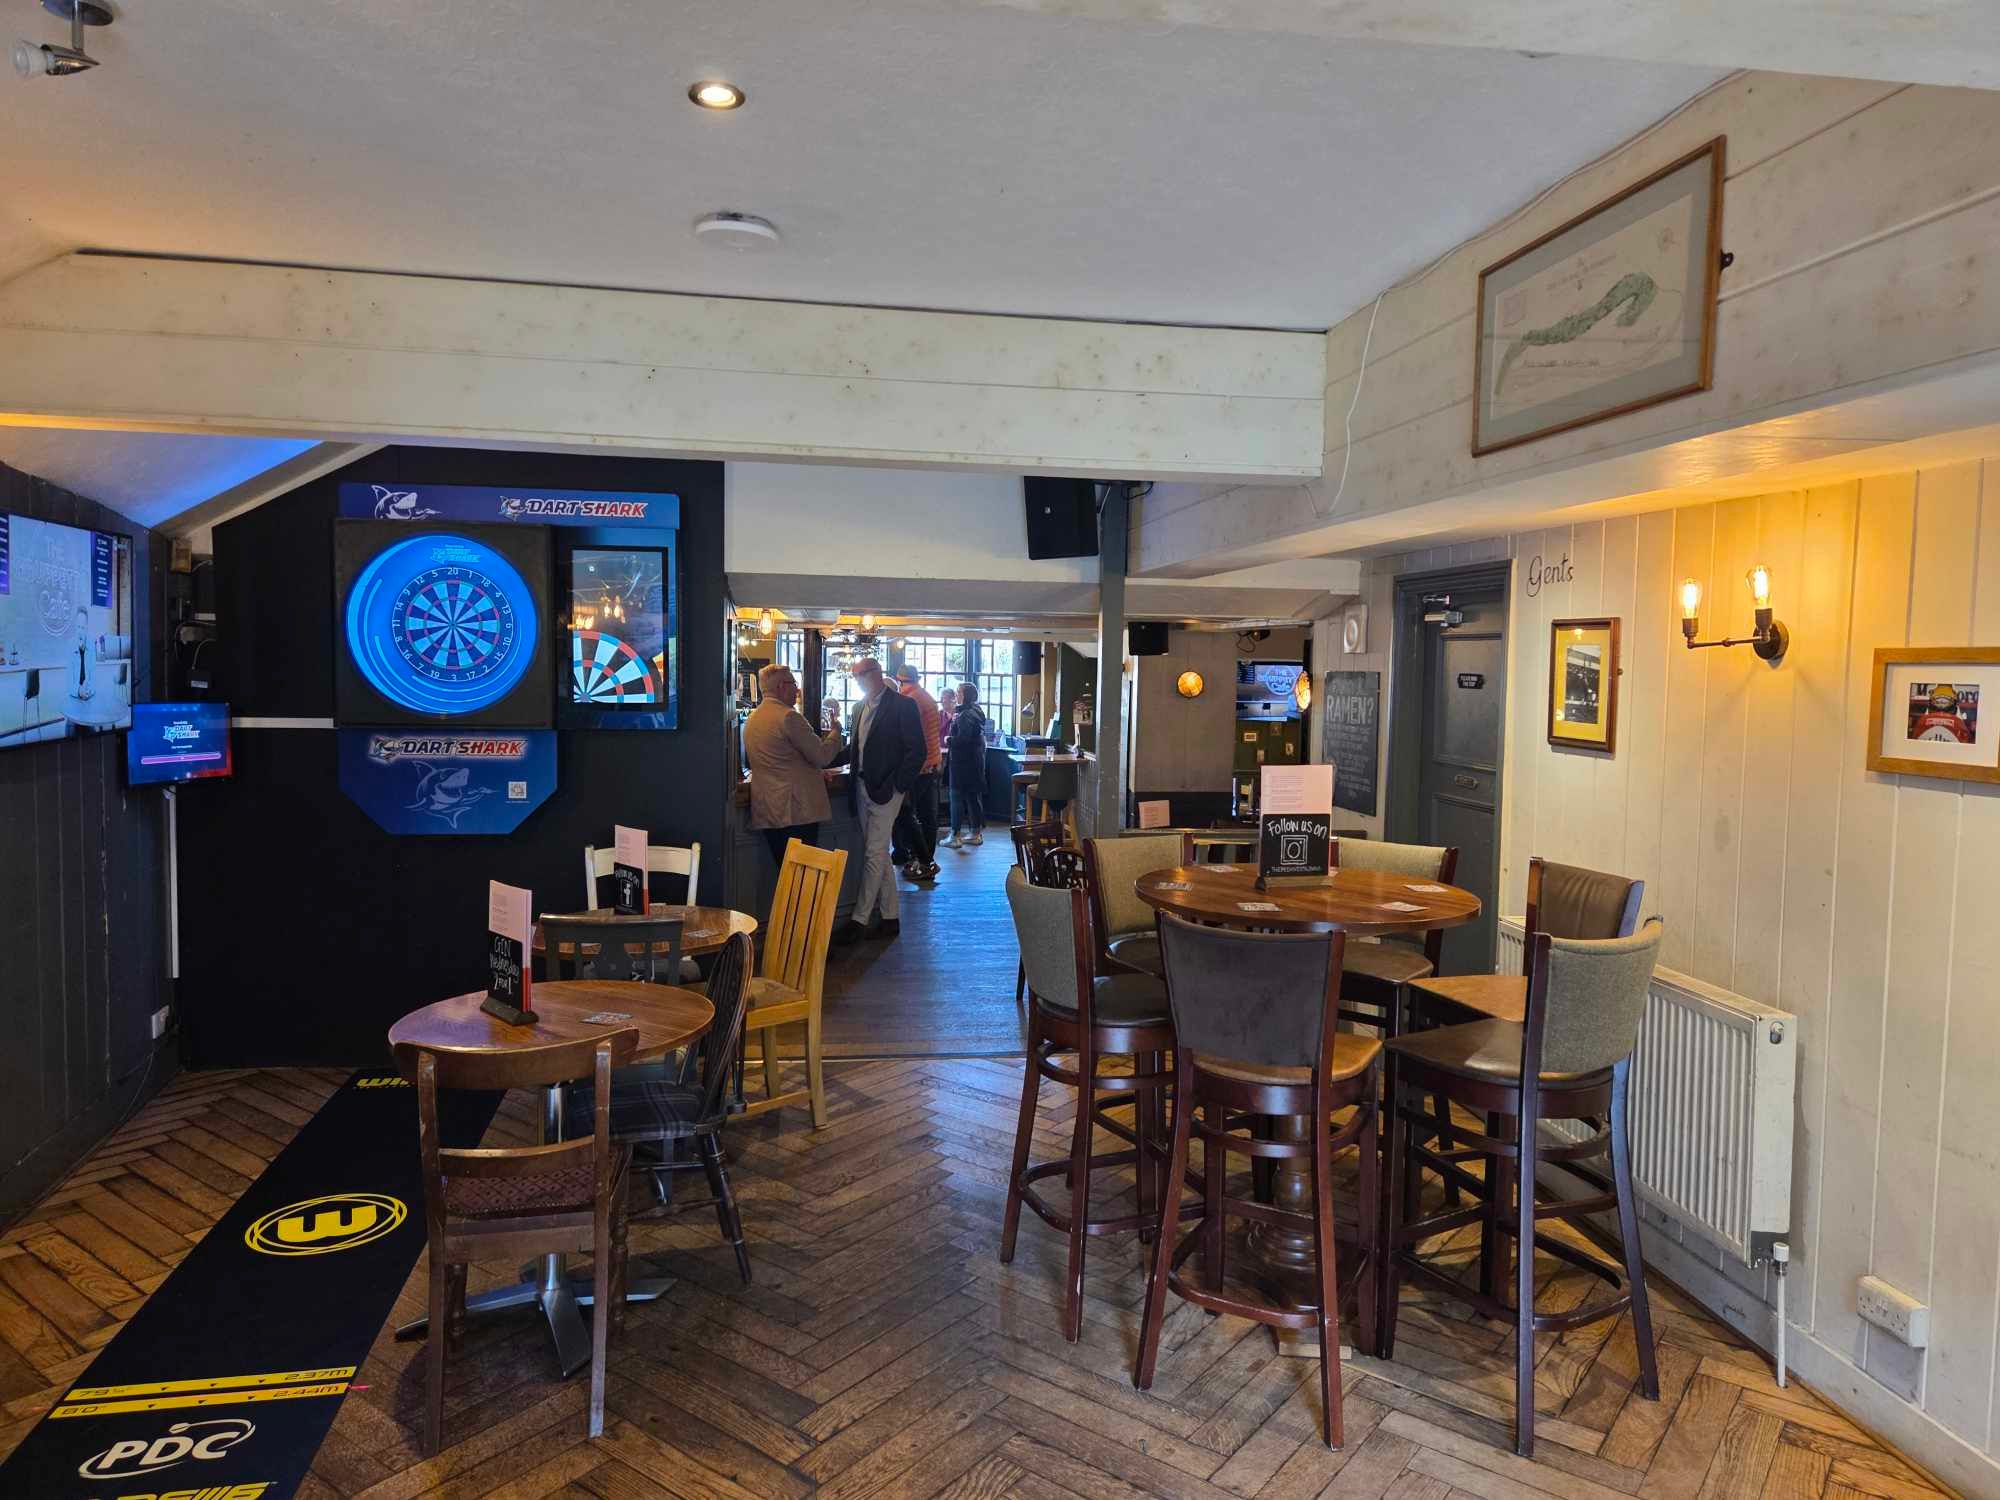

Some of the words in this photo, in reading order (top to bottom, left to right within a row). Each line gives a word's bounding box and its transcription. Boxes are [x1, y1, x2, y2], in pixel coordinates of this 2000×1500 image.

[526, 499, 580, 515] DART
[581, 501, 648, 518] SHARK
[1527, 553, 1575, 597] Gents
[1326, 694, 1375, 725] RAMEN?
[401, 739, 454, 756] DART
[457, 740, 525, 757] SHARK
[1266, 818, 1299, 836] Follow
[1301, 820, 1313, 833] us
[1314, 824, 1327, 840] on
[97, 1431, 241, 1470] PDC
